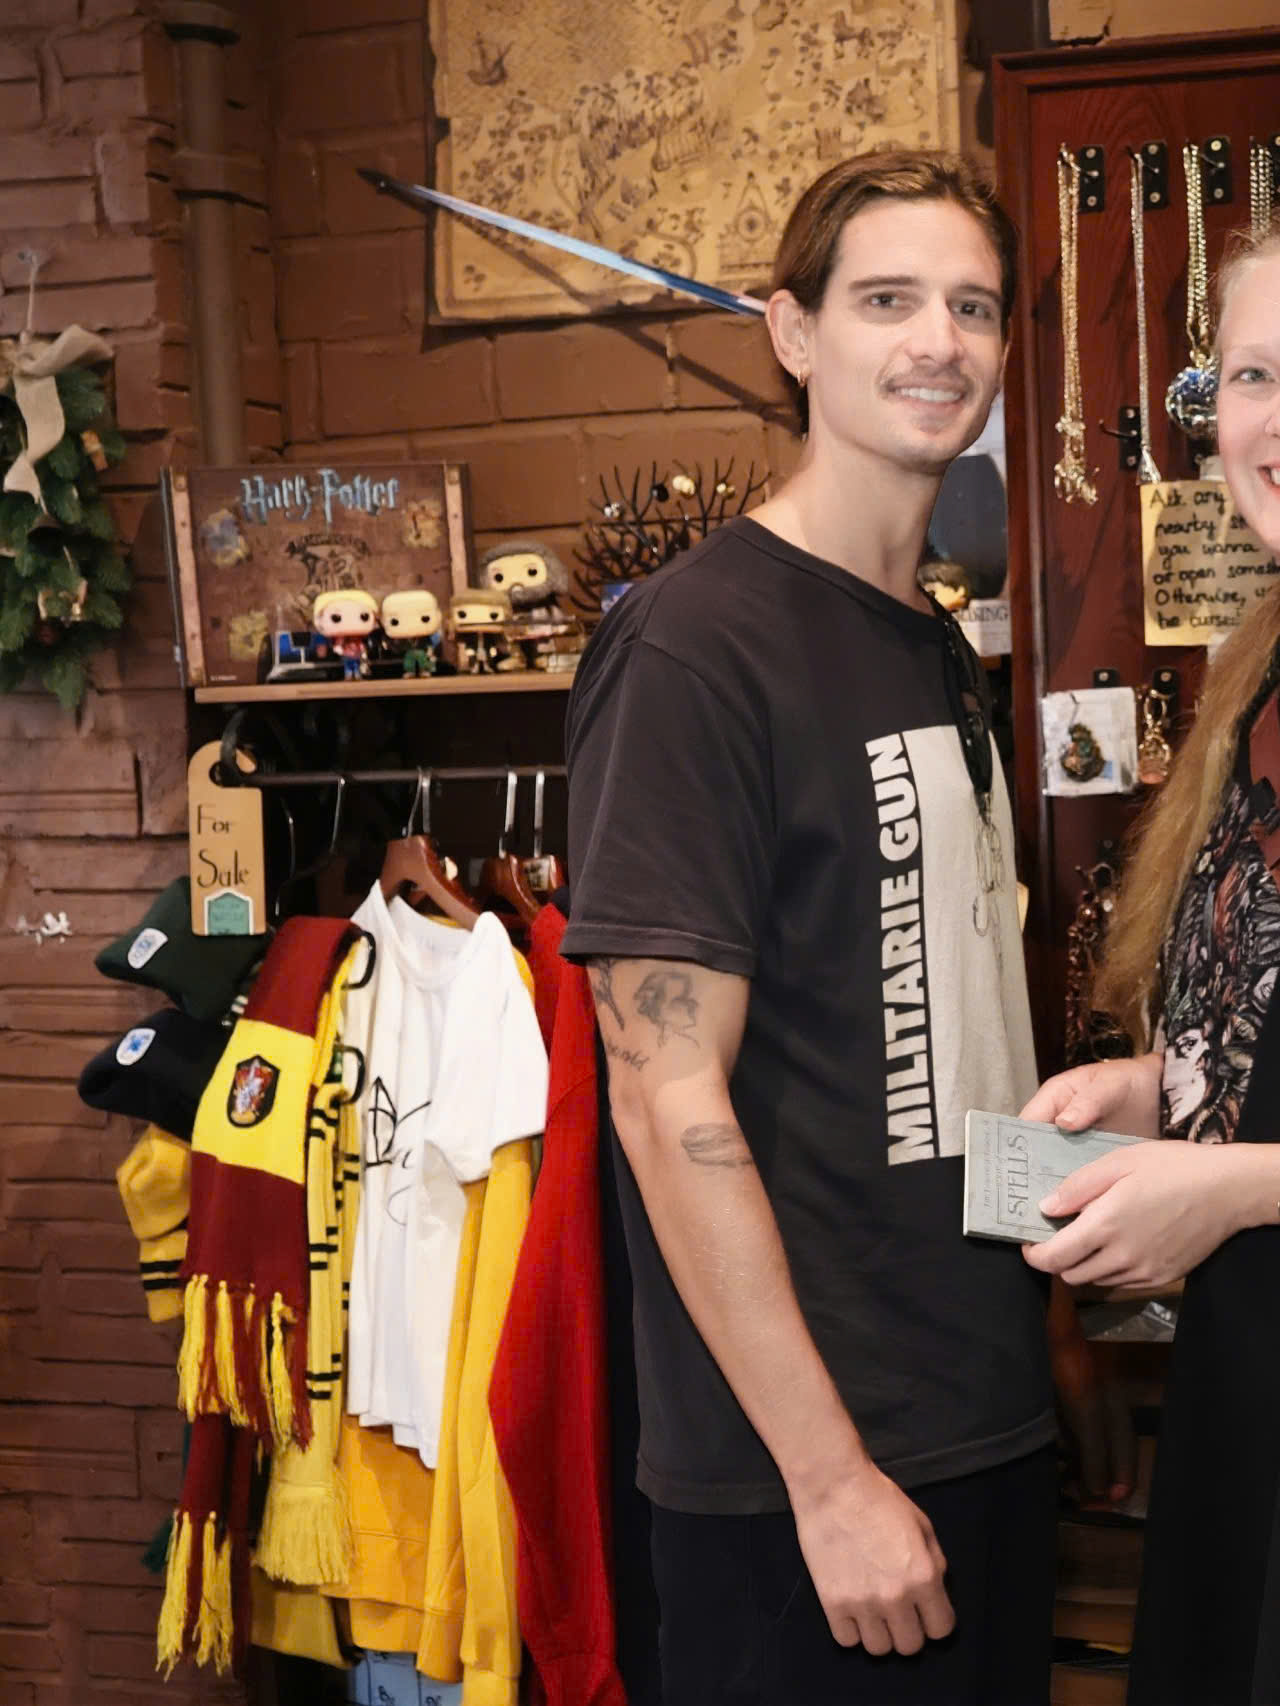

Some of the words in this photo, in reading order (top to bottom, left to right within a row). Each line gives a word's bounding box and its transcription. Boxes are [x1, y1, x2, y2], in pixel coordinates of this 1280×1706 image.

[239, 475, 313, 525] Harry
[316, 468, 400, 524] Potter
[1150, 489, 1186, 509] Ask
[1157, 544, 1191, 571] you
[1201, 542, 1260, 554] wanna
[1153, 573, 1175, 586] or
[1178, 567, 1216, 590] open
[1157, 612, 1181, 630] be
[865, 732, 921, 862] GUN
[196, 803, 237, 836] For
[196, 848, 251, 889] Sale
[880, 868, 936, 1167] MILITARIE
[1007, 1134, 1029, 1218] SPELLS
